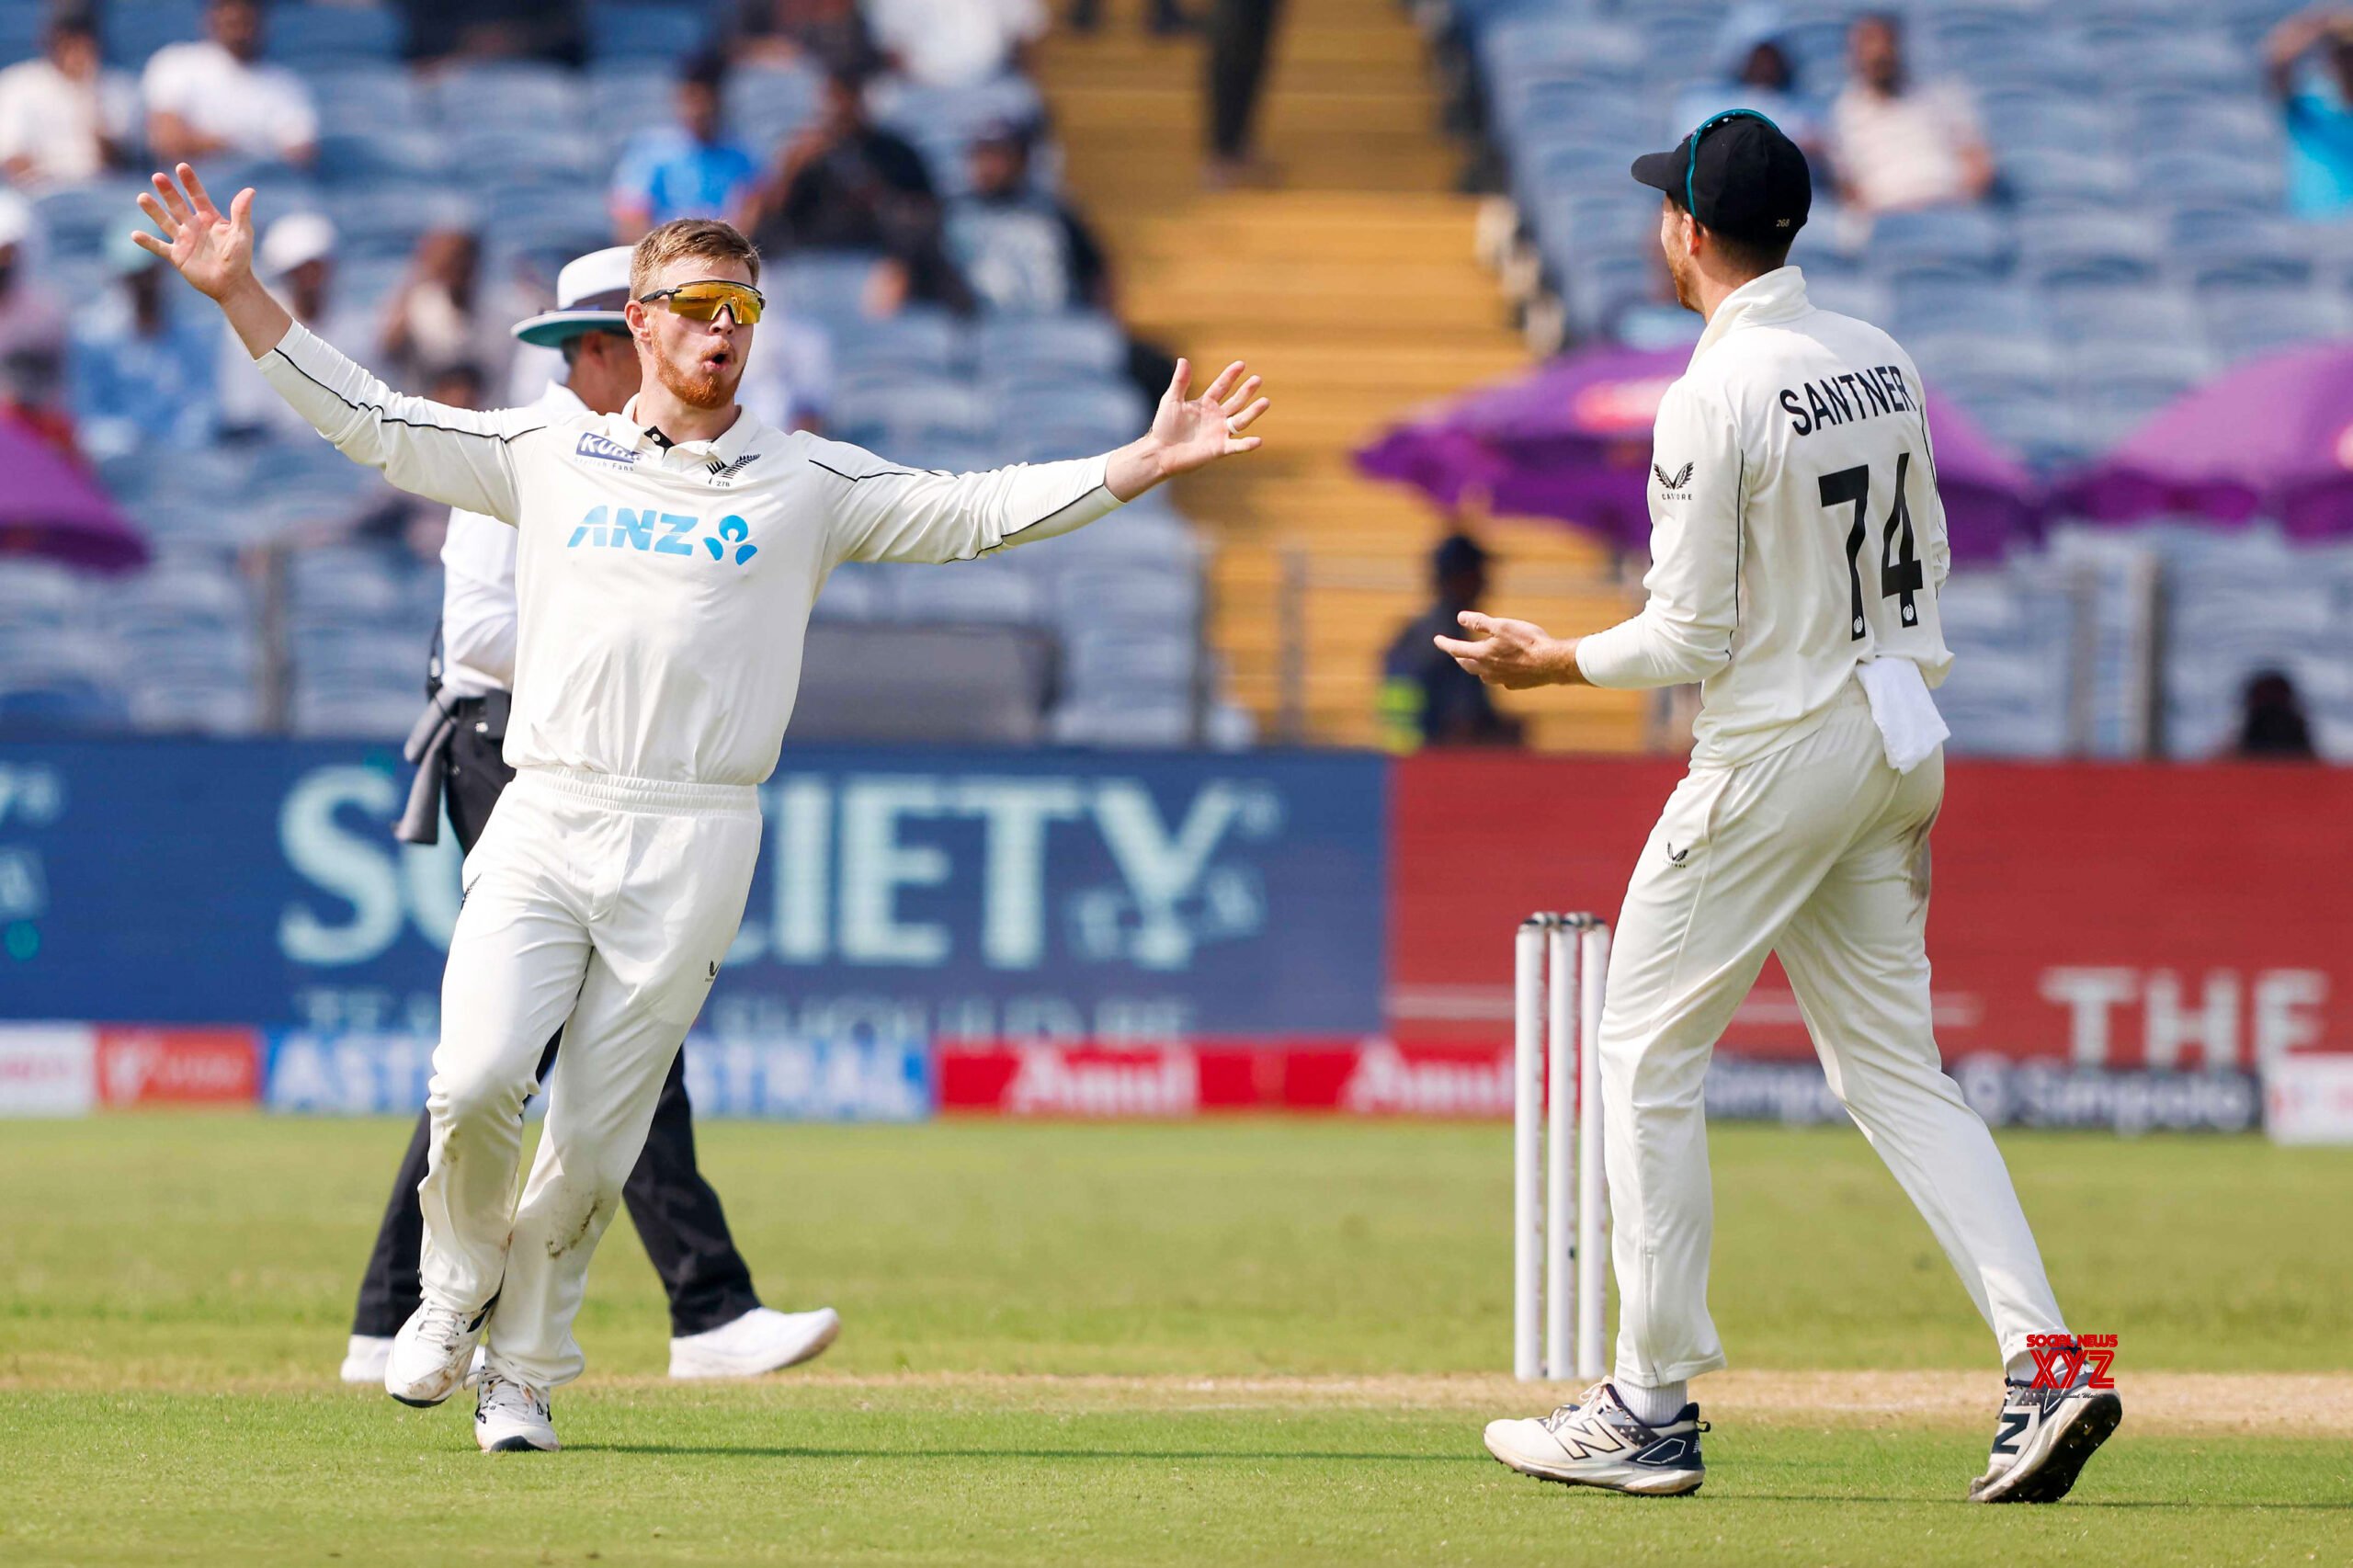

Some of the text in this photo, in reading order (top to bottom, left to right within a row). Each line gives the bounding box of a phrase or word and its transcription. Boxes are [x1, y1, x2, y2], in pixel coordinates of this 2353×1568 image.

[1776, 218, 1790, 228] 268
[1779, 365, 1917, 437] SANTNER
[612, 462, 634, 472] Fans
[567, 505, 699, 556] ANZ
[1817, 451, 1924, 642] 74
[280, 765, 1245, 971] SIETY
[2038, 964, 2331, 1070] THE
